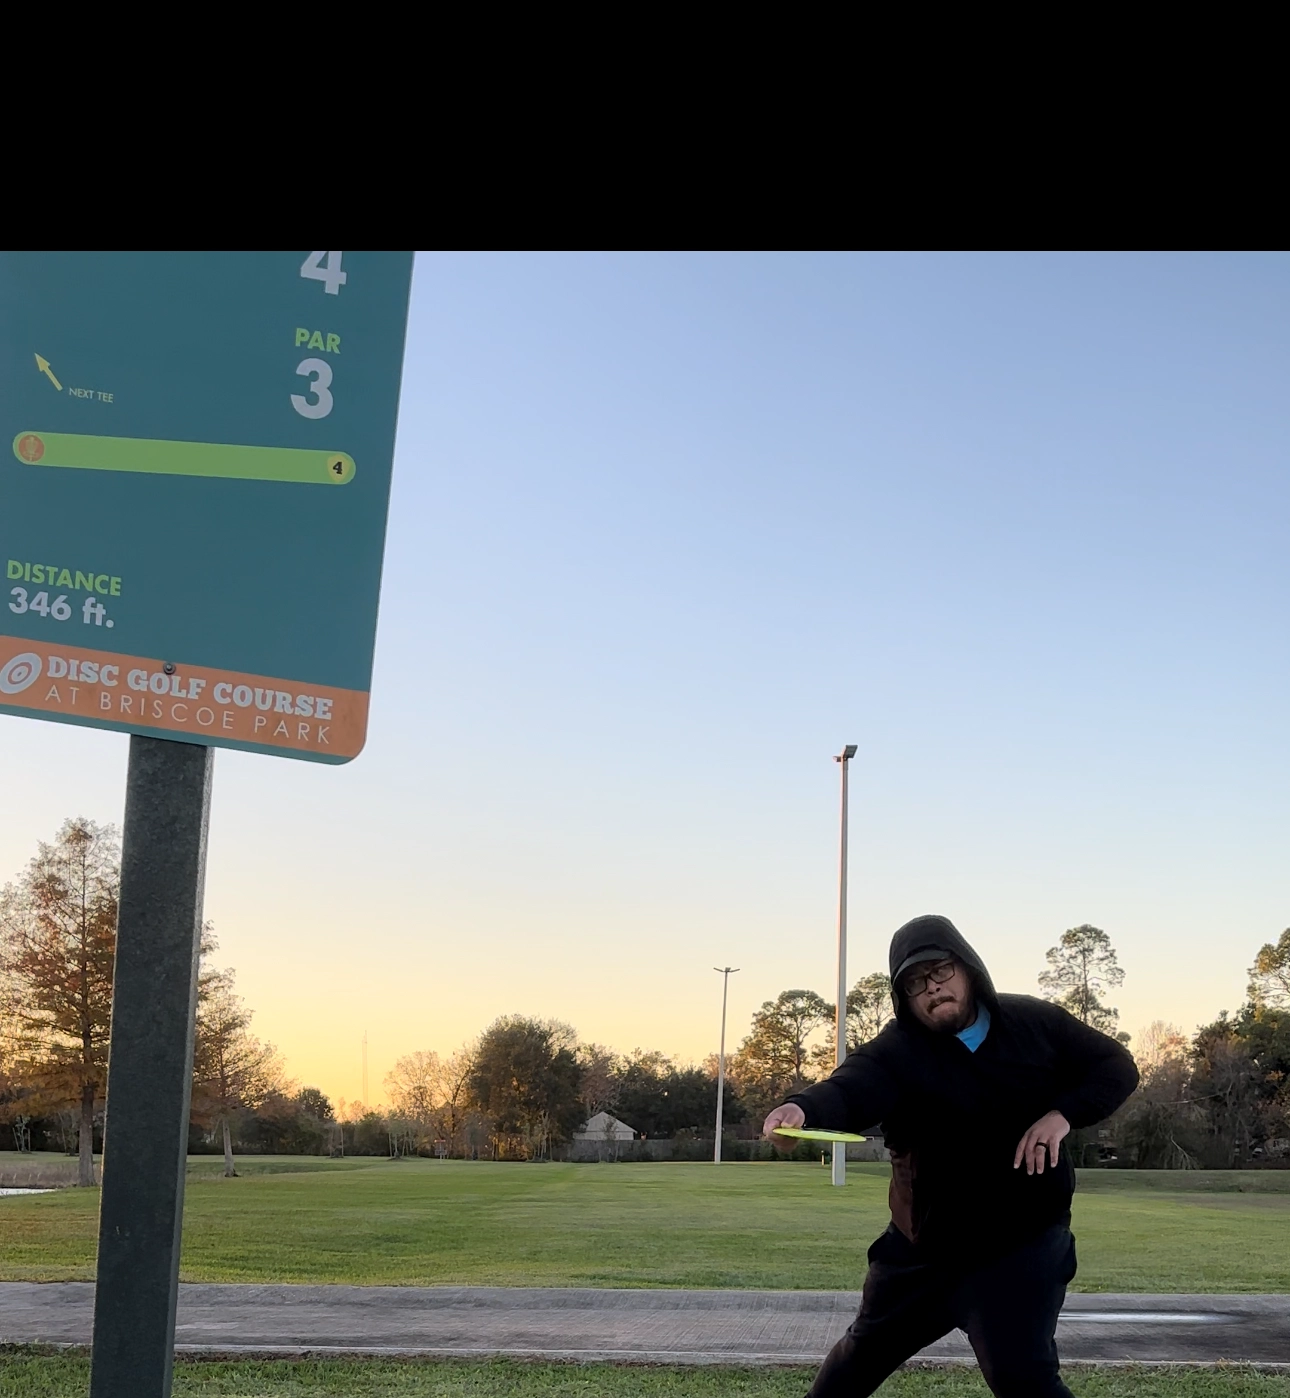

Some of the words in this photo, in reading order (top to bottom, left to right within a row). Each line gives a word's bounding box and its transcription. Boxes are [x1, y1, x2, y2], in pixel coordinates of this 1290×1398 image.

[300, 251, 348, 296] 4
[295, 328, 341, 355] PAR
[69, 387, 95, 400] NEXT
[97, 391, 114, 404] TEE
[290, 357, 335, 420] 3
[332, 461, 343, 475] 4
[7, 559, 122, 596] DISTANCE
[8, 586, 72, 621] 346
[82, 596, 115, 628] ft.
[47, 656, 119, 687] DISC
[127, 669, 207, 700] GOLF
[213, 682, 334, 721] COURSE
[45, 684, 80, 705] AT
[100, 691, 235, 730] BRISCOE
[253, 715, 331, 745] PARK
